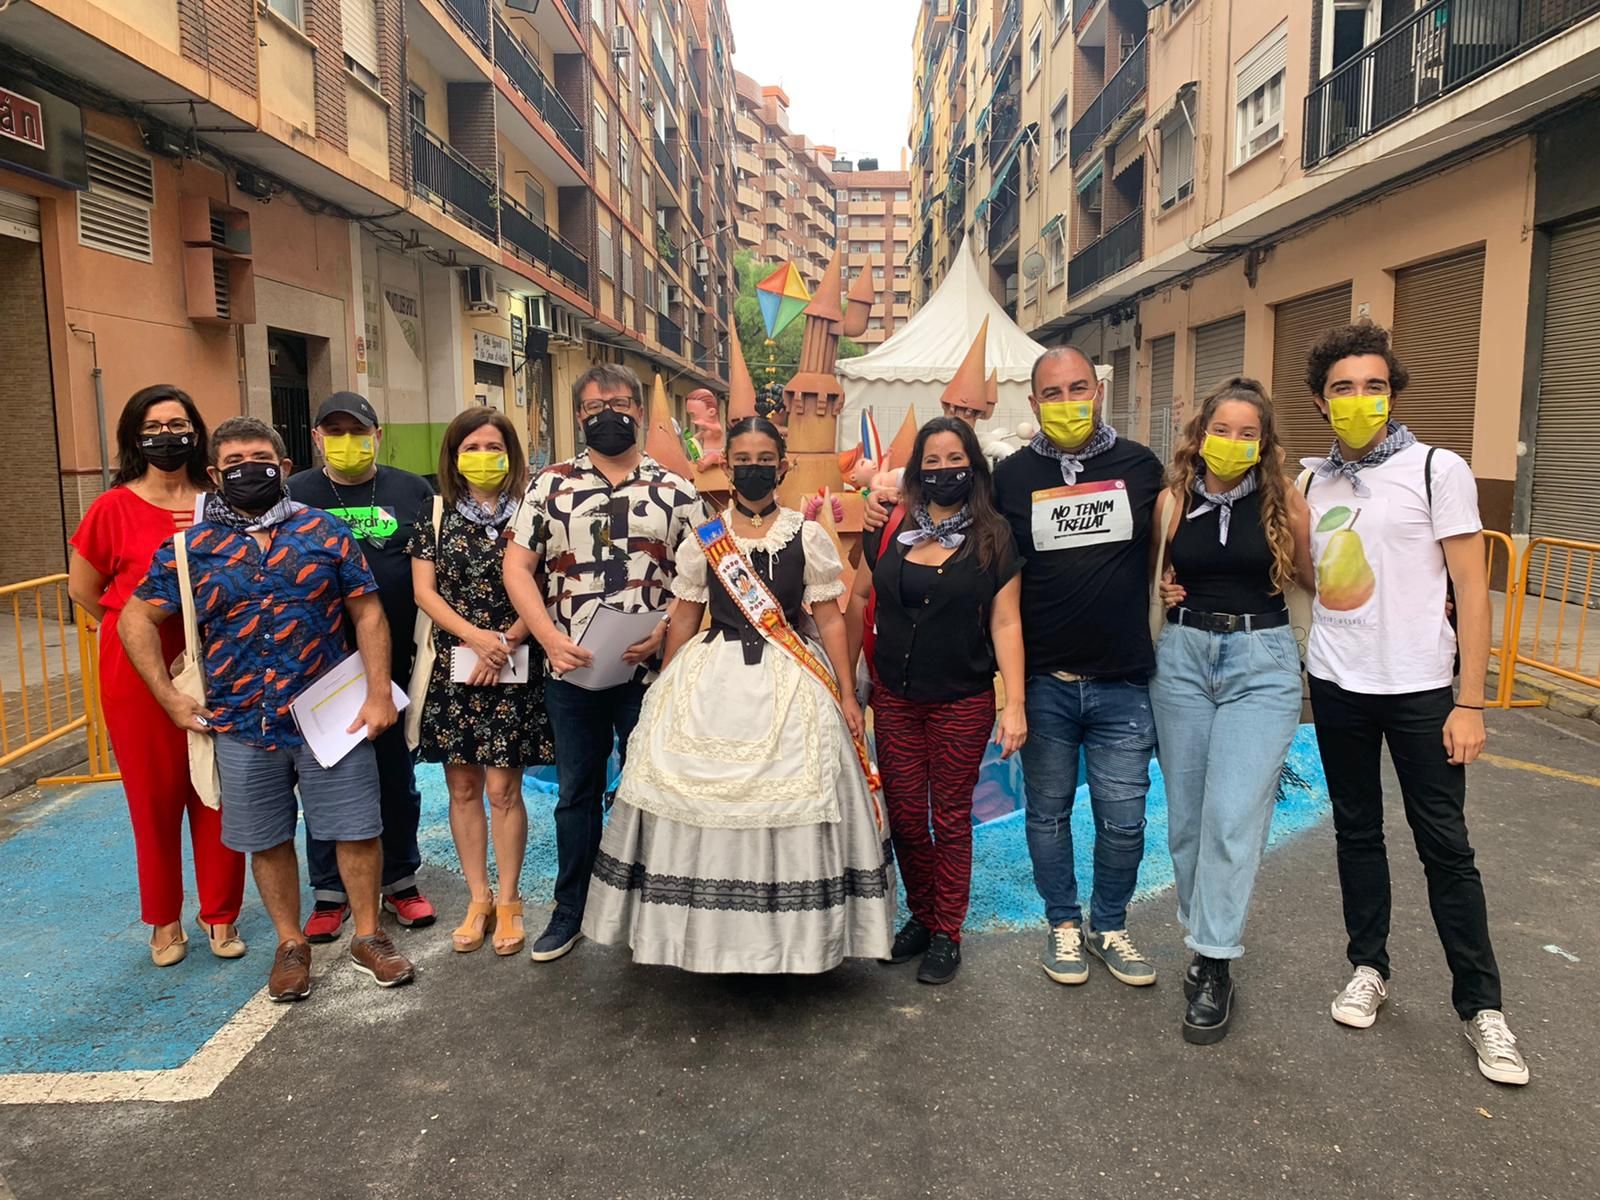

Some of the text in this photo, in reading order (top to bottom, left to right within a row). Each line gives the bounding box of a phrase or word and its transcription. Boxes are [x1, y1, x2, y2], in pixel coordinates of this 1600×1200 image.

[1051, 500, 1115, 521] NO TENIM
[1056, 513, 1107, 532] TRELLAT
